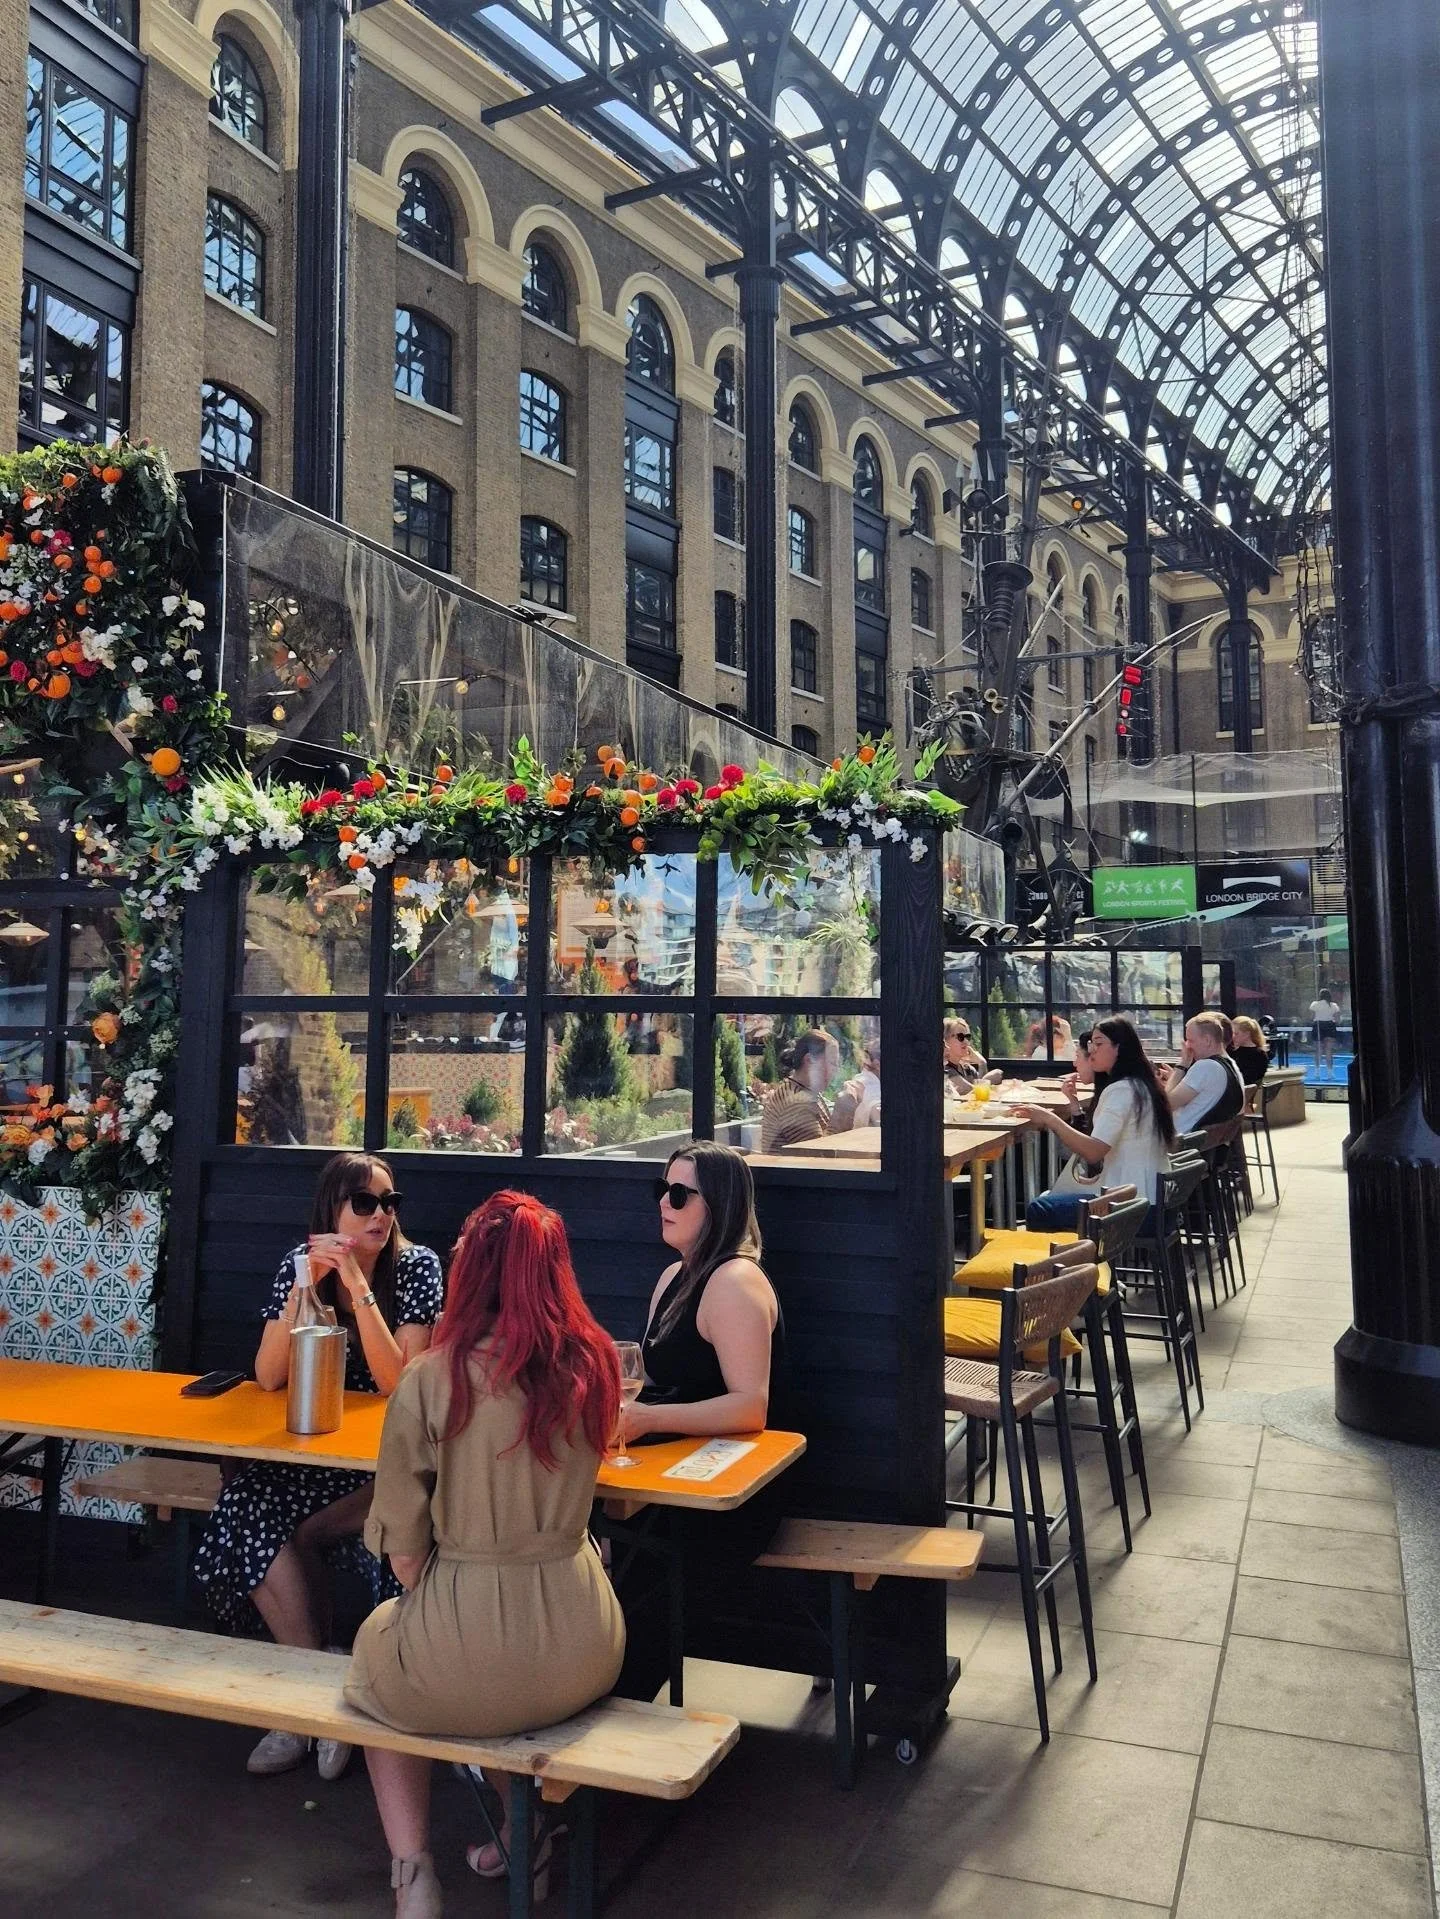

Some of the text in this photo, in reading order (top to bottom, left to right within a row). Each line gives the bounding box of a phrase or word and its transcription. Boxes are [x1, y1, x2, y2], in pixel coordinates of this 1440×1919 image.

[1206, 891, 1303, 903] LONDON BRIDGE CITY
